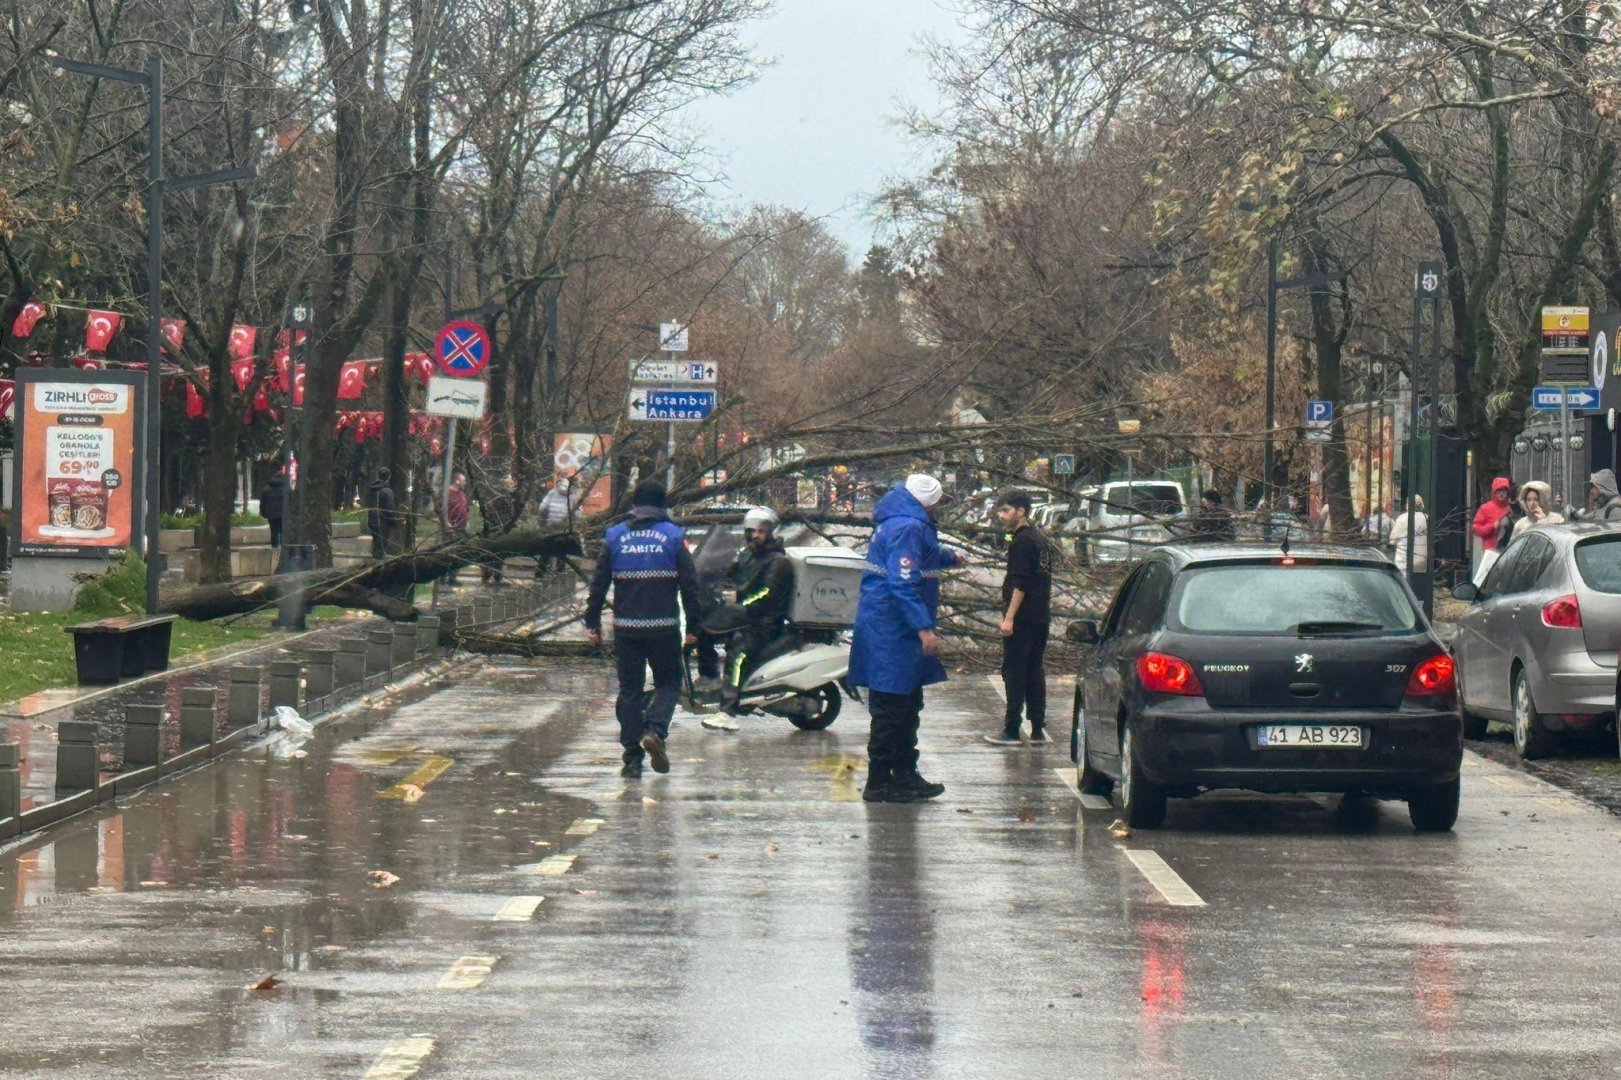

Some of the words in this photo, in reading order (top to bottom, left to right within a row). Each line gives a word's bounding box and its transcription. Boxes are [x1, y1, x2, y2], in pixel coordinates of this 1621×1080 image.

[45, 391, 86, 403] ZIRHLI
[648, 407, 702, 418] Ankara
[1313, 403, 1325, 420] P
[59, 442, 100, 450] GRANOLA
[621, 544, 664, 554] ZABITA
[1203, 664, 1250, 673] PEUGEOT
[1384, 664, 1407, 673] 307
[1268, 727, 1288, 743] 41
[1298, 726, 1324, 743] AB
[1329, 726, 1360, 743] 923
